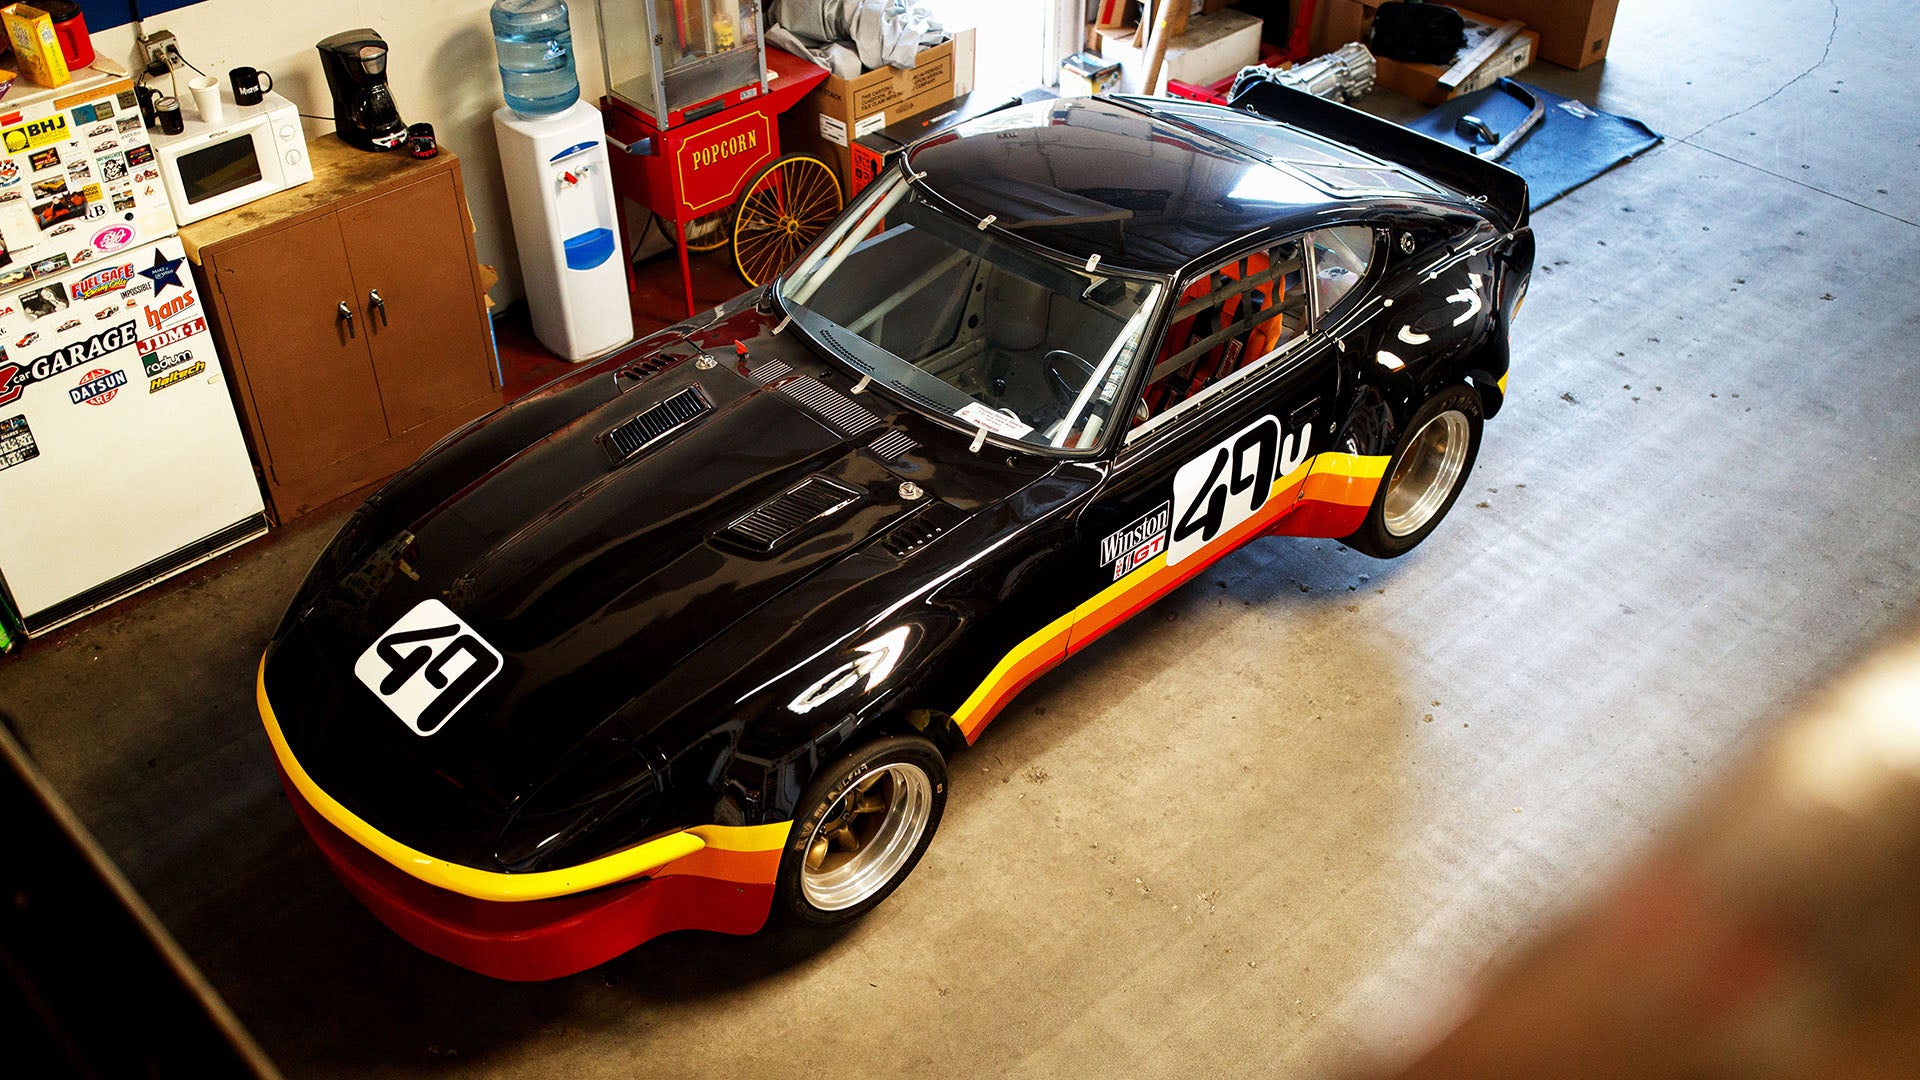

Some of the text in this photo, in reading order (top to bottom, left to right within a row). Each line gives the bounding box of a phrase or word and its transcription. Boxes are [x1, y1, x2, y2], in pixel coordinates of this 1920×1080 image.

[27, 116, 66, 137] BHJ
[692, 130, 757, 171] POPCORN
[70, 262, 135, 299] FUEL SAFE
[120, 281, 152, 299] IMPOSSIBLE
[144, 290, 195, 330] hans
[31, 322, 137, 380] GARAGE
[72, 371, 127, 403] DATSUN
[151, 361, 206, 390] Haltech
[1173, 419, 1278, 543] 49
[1102, 508, 1168, 564] Winston
[1133, 535, 1164, 565] GT
[376, 623, 499, 733] 49
